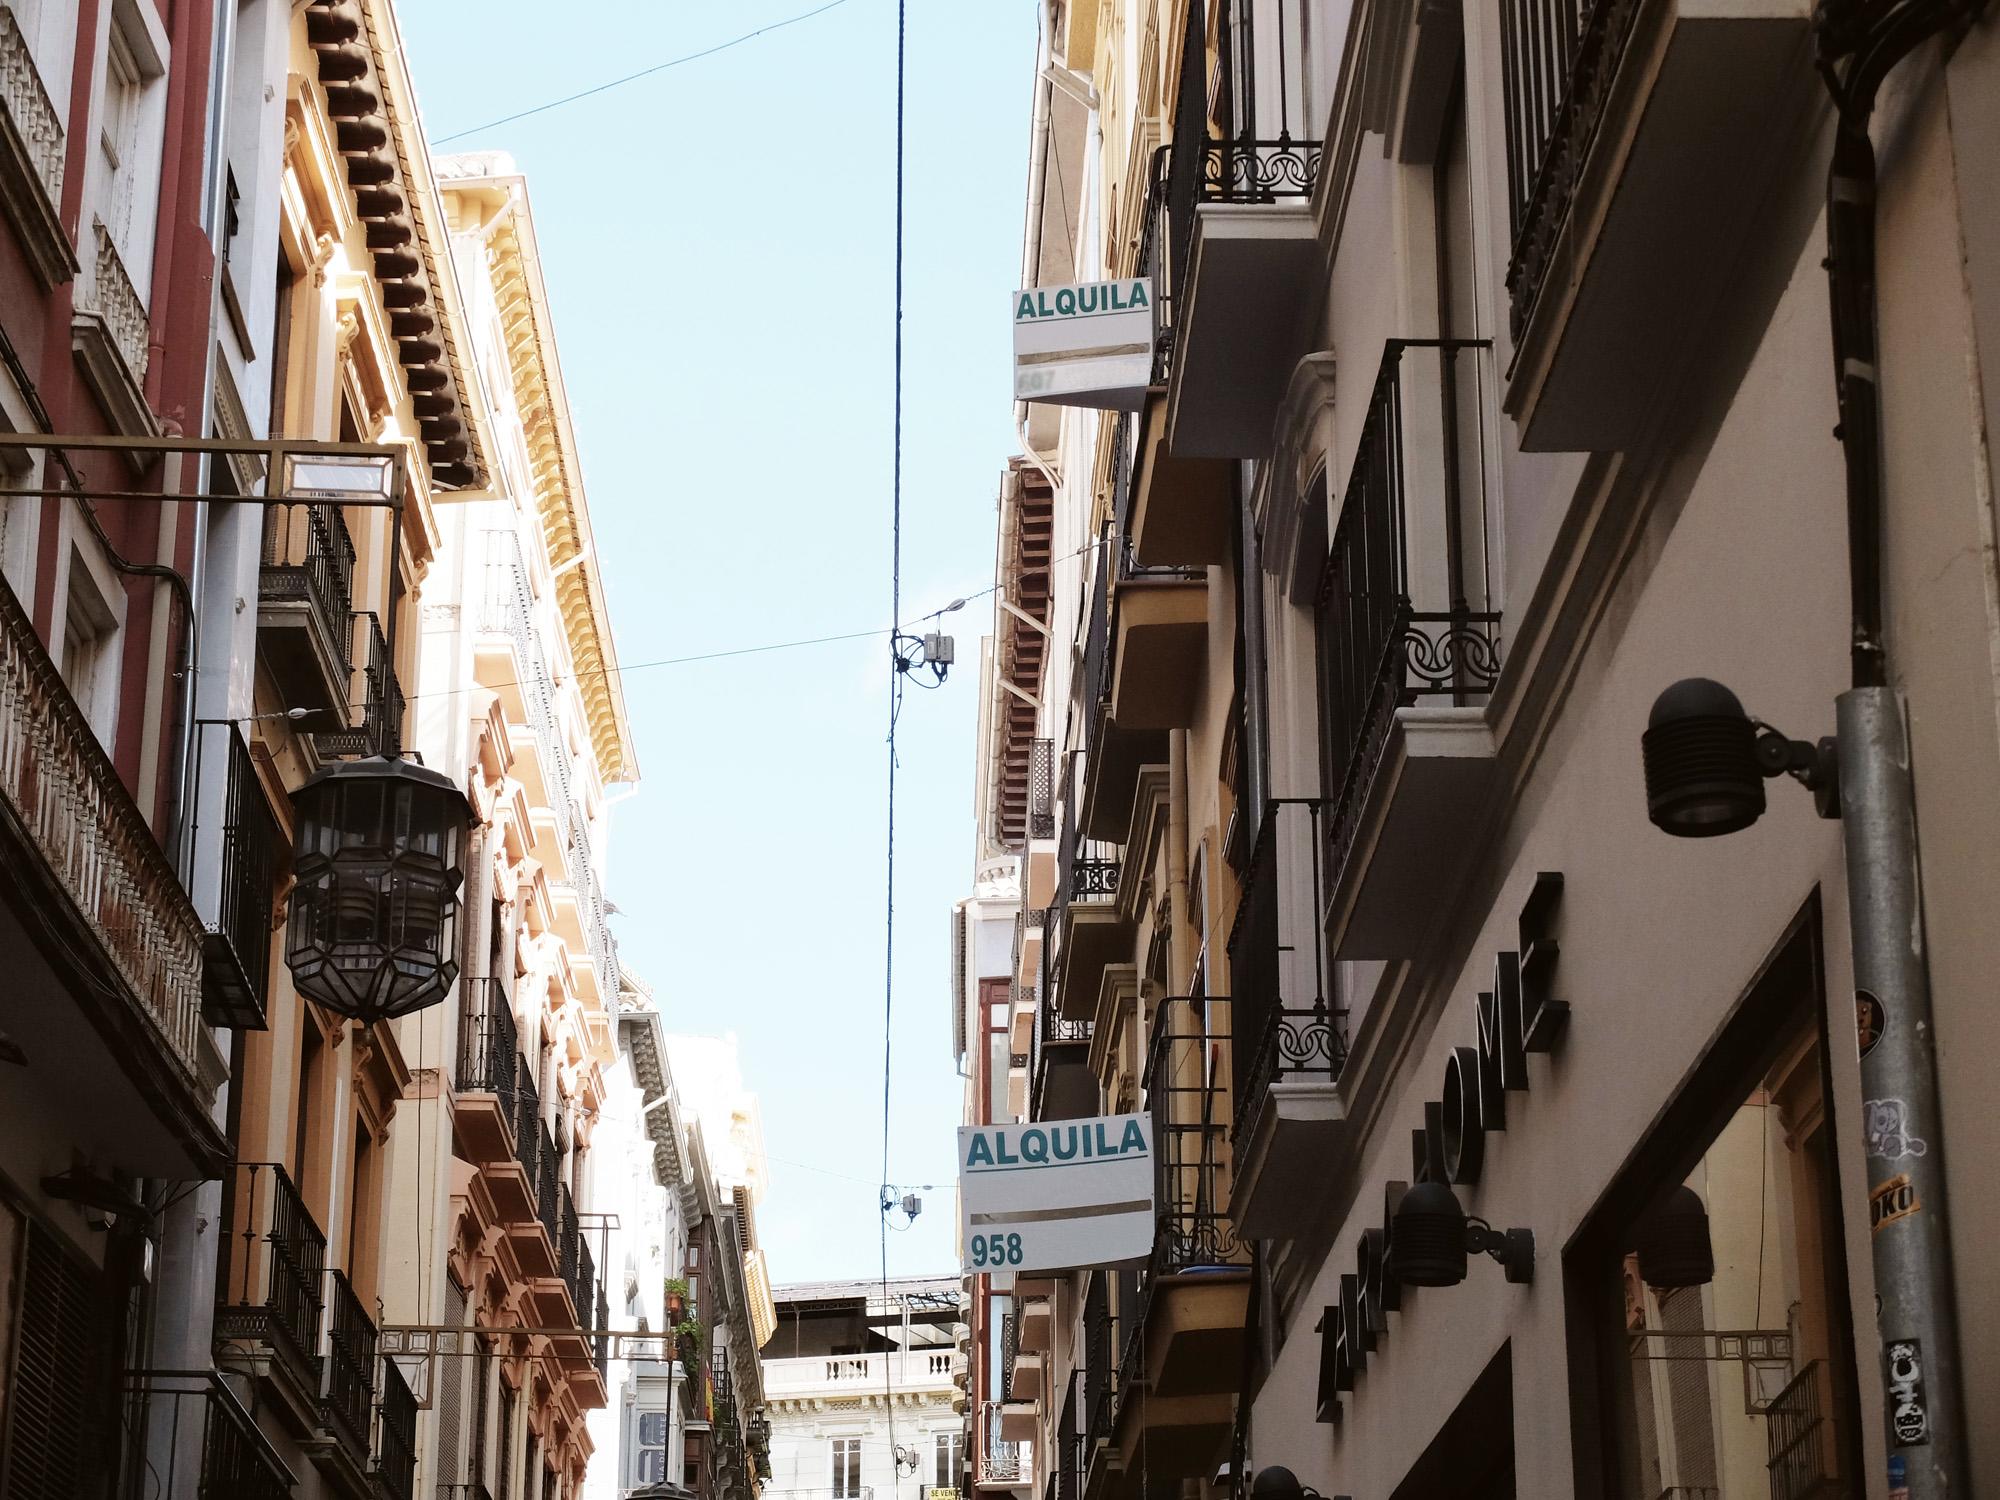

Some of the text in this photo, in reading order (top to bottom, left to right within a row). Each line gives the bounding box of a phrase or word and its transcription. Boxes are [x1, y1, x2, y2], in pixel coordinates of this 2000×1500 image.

[1016, 282, 1149, 319] ALQUILA
[966, 1119, 1148, 1166] ALQUILA
[971, 1232, 1023, 1267] 958
[941, 1489, 956, 1497] VEND
